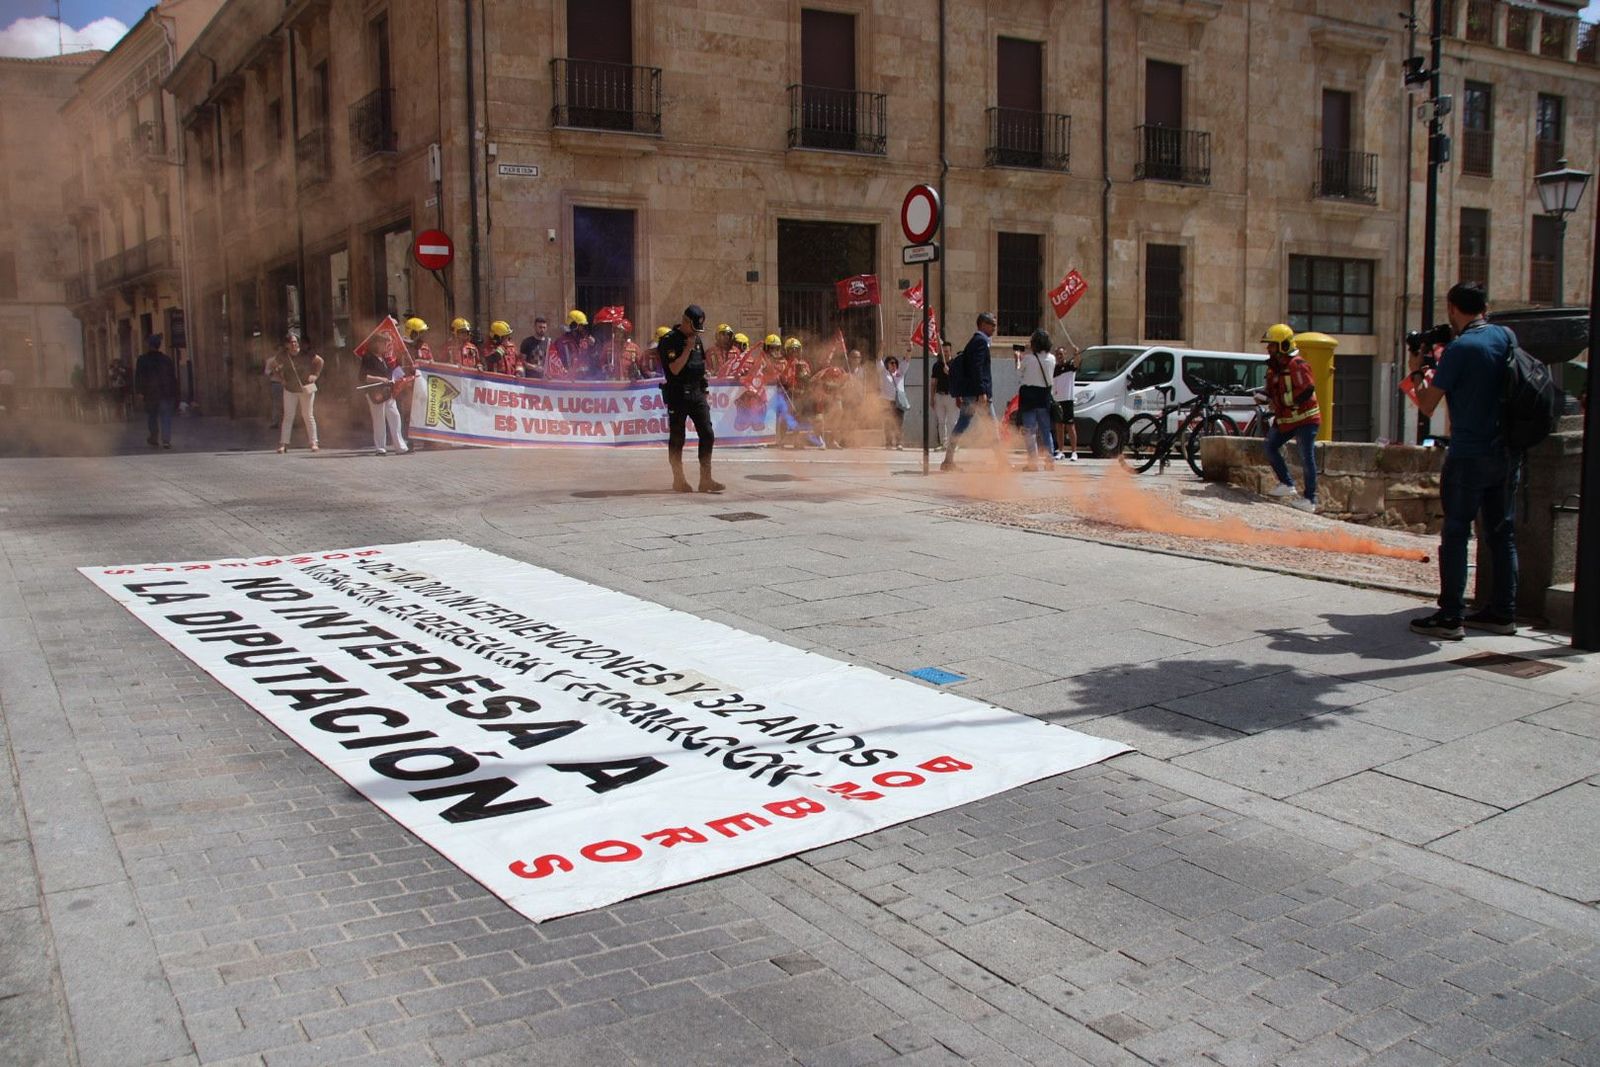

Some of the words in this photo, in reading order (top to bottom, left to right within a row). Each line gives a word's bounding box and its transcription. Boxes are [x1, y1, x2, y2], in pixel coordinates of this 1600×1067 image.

[474, 387, 553, 411] NUESTRA
[558, 397, 620, 413] LUCHA
[623, 397, 636, 412] Y
[495, 415, 517, 432] ES
[521, 417, 606, 436] VUESTRA
[124, 581, 210, 606] LA
[165, 611, 551, 823] DIPUTACIÓN
[222, 577, 313, 601] NO
[271, 606, 587, 750] INTERESA
[547, 756, 668, 793] A
[357, 563, 407, 575] DE
[436, 597, 684, 685] INTERVENCIONES
[666, 682, 720, 696] Y
[694, 694, 765, 717] 32
[739, 715, 898, 766] AÑOS
[508, 755, 974, 879] BOMBEROS
